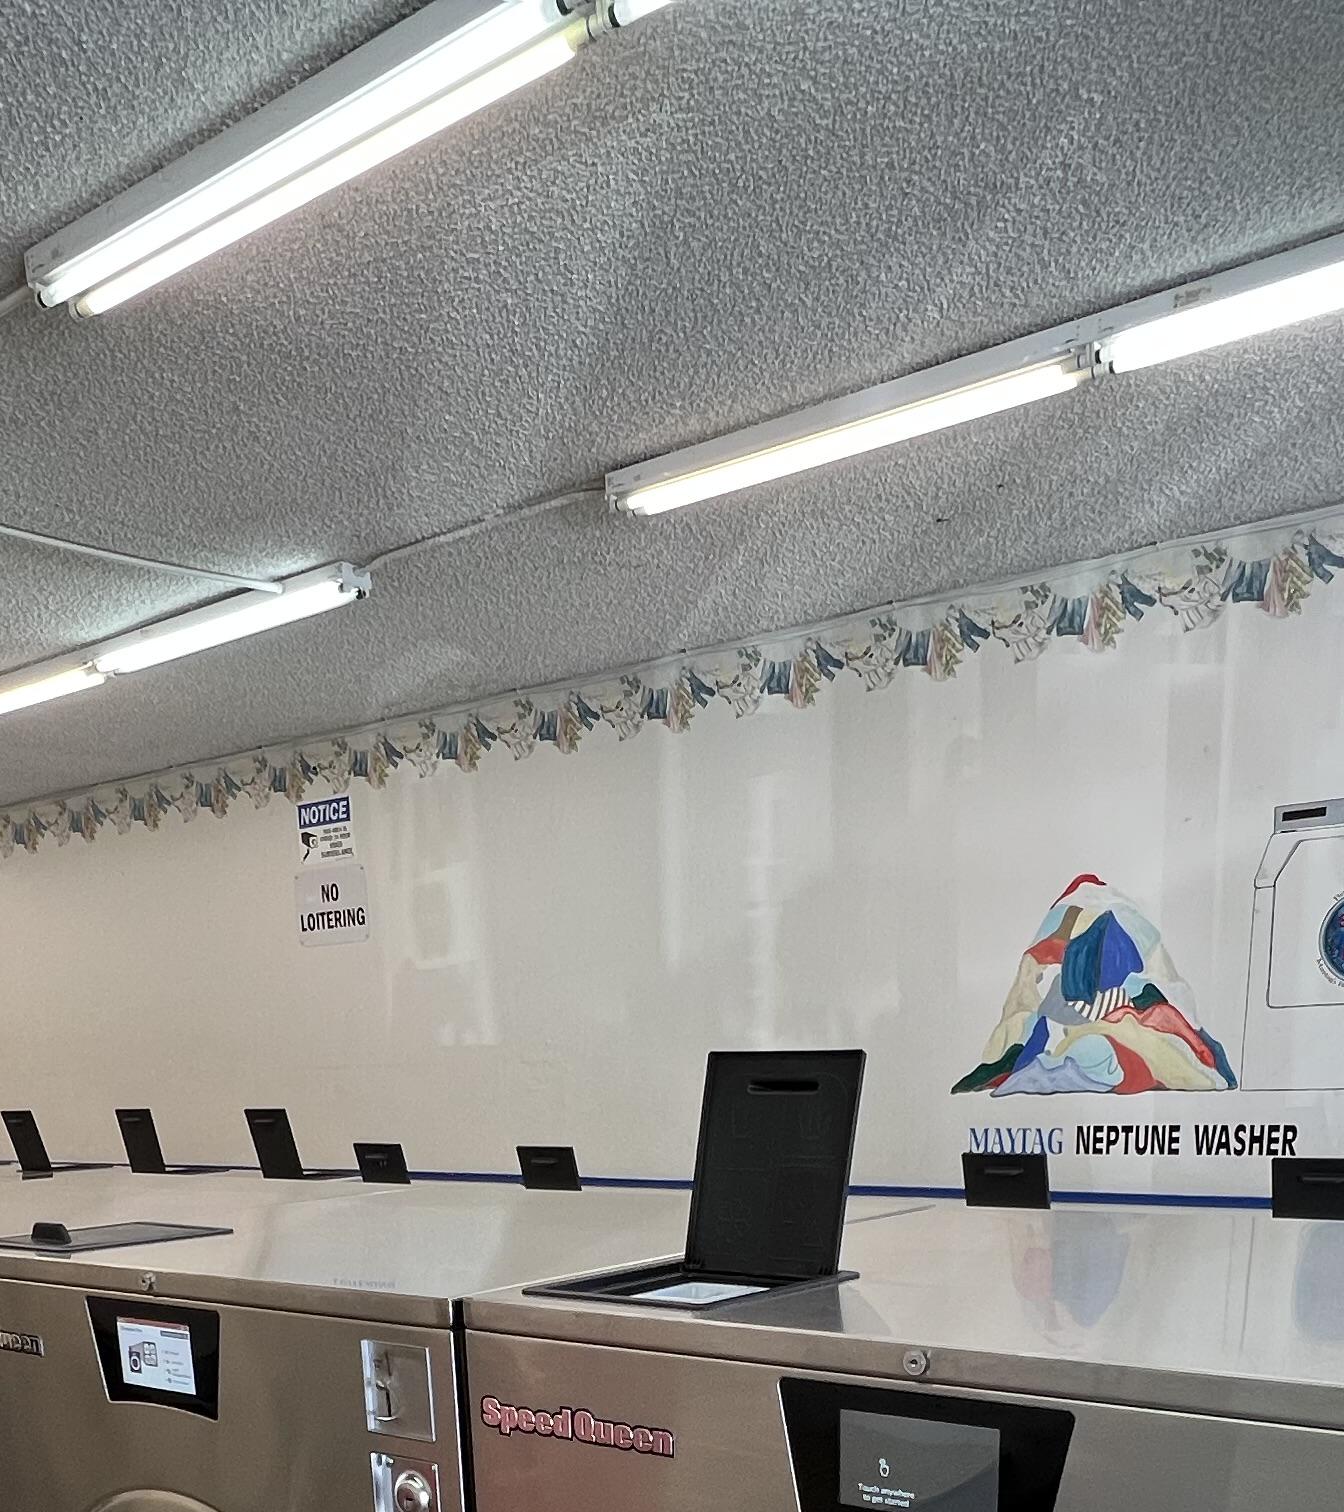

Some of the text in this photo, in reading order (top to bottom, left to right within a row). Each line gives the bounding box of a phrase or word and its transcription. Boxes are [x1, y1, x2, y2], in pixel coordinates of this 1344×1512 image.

[300, 800, 348, 826] NOTICE
[321, 883, 339, 903] NO
[300, 907, 366, 932] LOITERING
[968, 1127, 1064, 1156] MAYTAG
[1075, 1124, 1181, 1156] NEPTUNE
[1194, 1124, 1299, 1157] WASHER
[481, 1394, 675, 1459] Speed Queen
